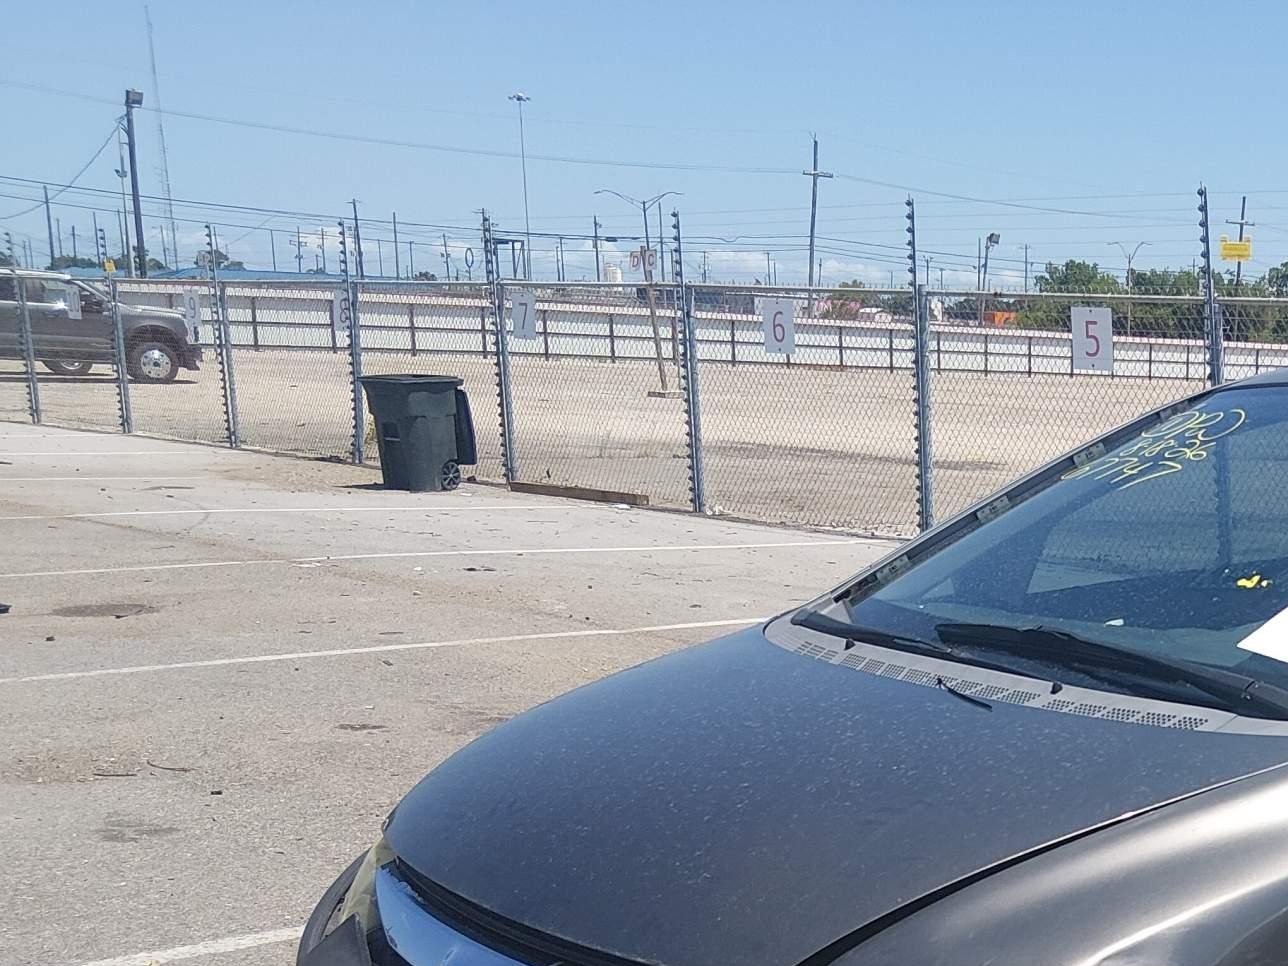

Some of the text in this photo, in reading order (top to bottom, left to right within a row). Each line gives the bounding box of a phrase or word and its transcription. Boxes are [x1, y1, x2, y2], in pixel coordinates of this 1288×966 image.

[632, 255, 640, 268] D
[648, 253, 655, 266] C
[188, 296, 196, 319] 9
[518, 302, 528, 329] 7
[772, 311, 785, 343] 6
[1085, 320, 1100, 357] 5
